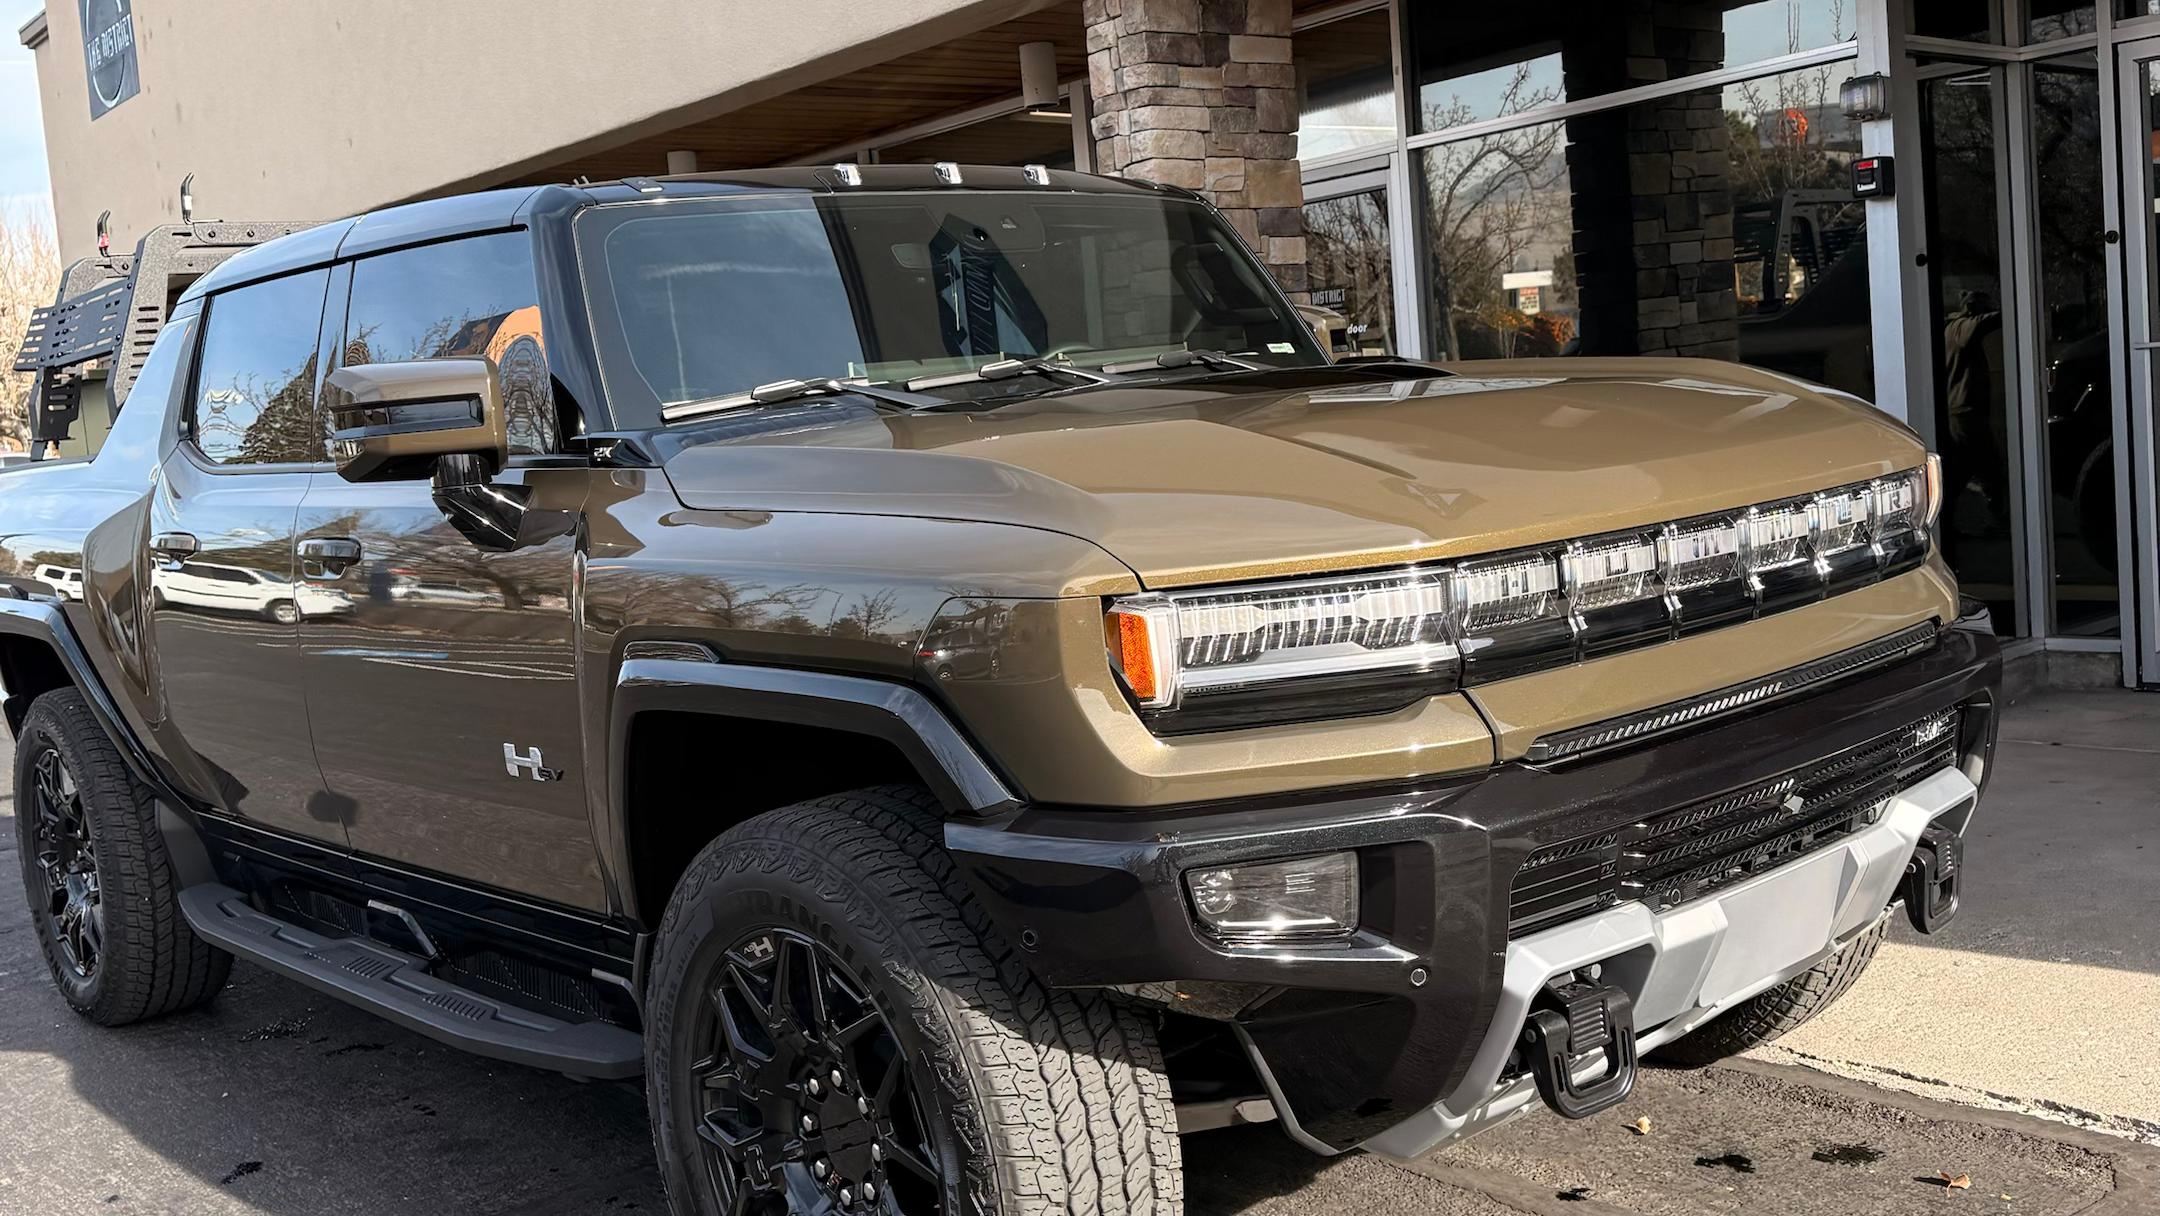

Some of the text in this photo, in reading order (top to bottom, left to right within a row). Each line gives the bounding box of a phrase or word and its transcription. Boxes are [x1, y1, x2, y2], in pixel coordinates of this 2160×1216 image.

[87, 13, 133, 71] THE DISTRICT
[1311, 288, 1345, 305] DISTRICT
[1347, 323, 1368, 334] door
